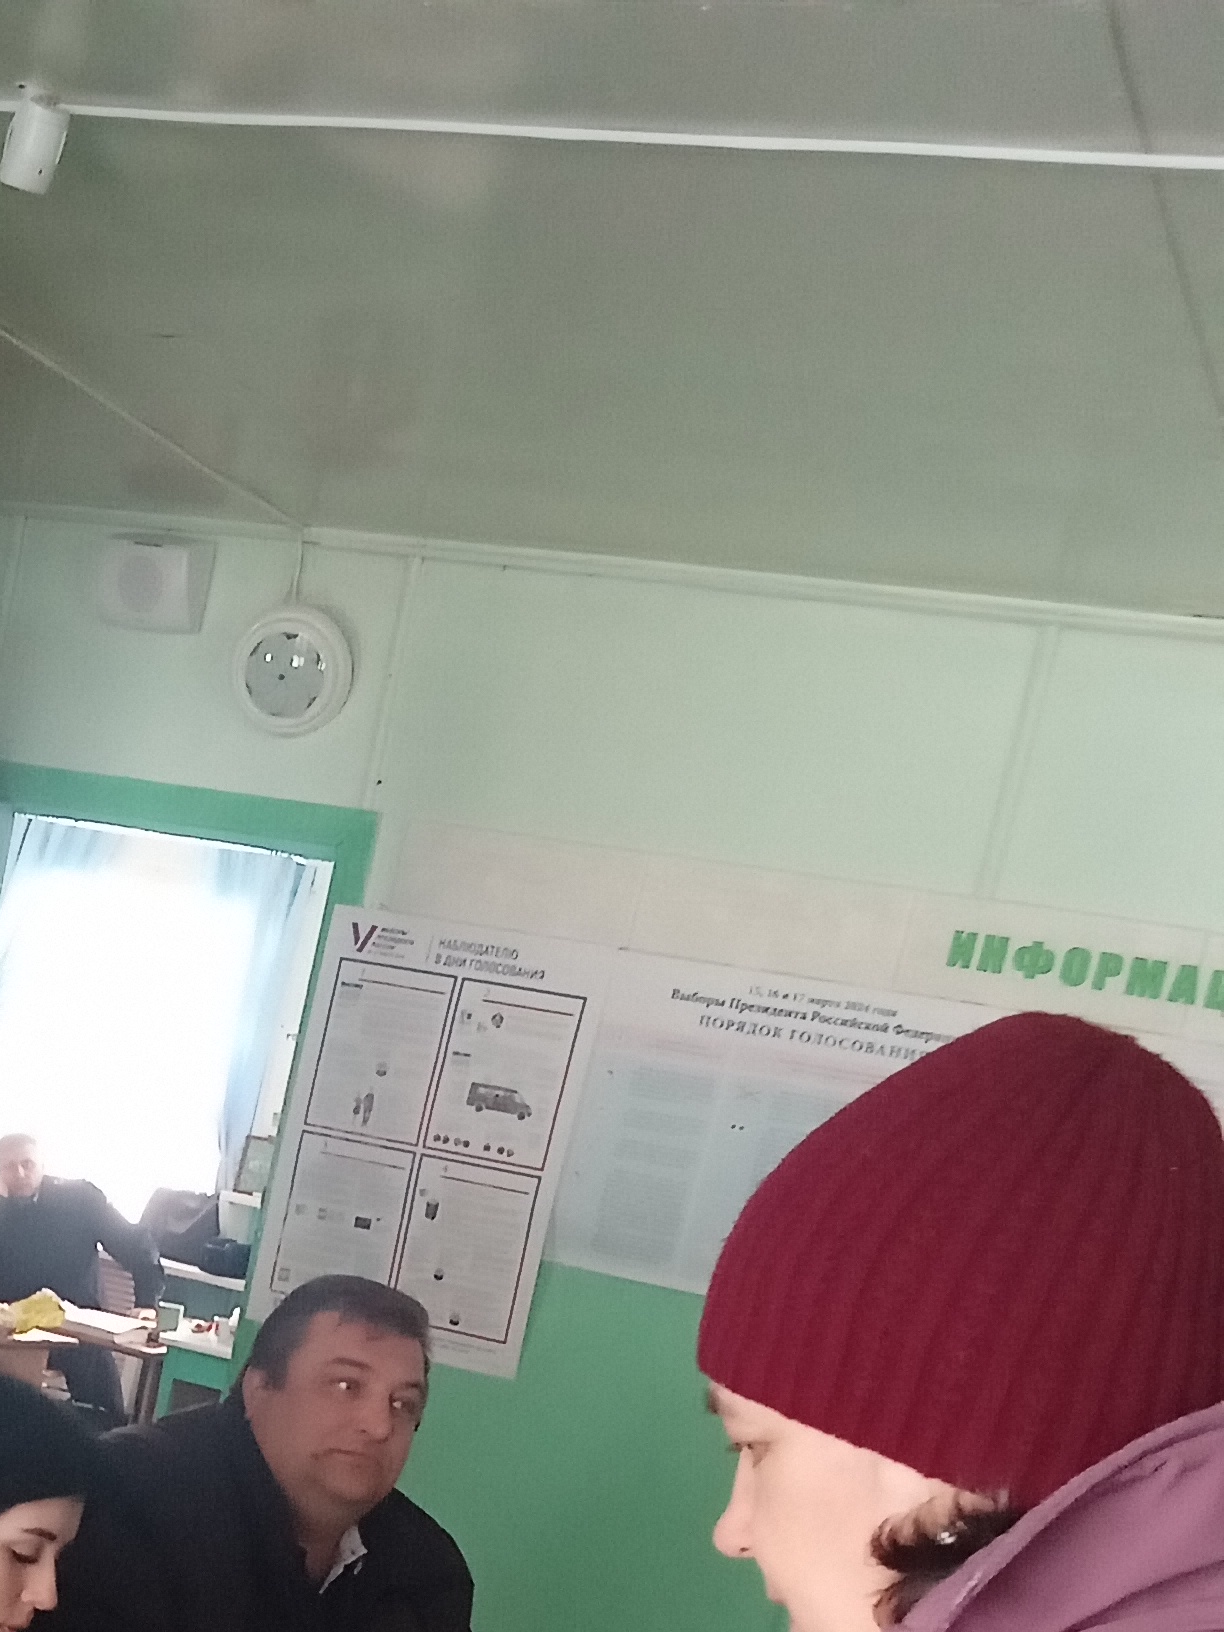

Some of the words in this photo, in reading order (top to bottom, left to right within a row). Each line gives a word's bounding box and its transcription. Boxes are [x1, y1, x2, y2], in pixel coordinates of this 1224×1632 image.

[438, 938, 519, 961] НАБЛЮДАТЕЛЮ
[443, 955, 468, 968] ДНИ
[468, 958, 546, 981] ГОЛОСОВАНИЯ
[671, 988, 726, 1008] Выборы
[729, 997, 808, 1021] Президента
[810, 1010, 890, 1033] Российской
[699, 1015, 785, 1039] ПОРЯДОК
